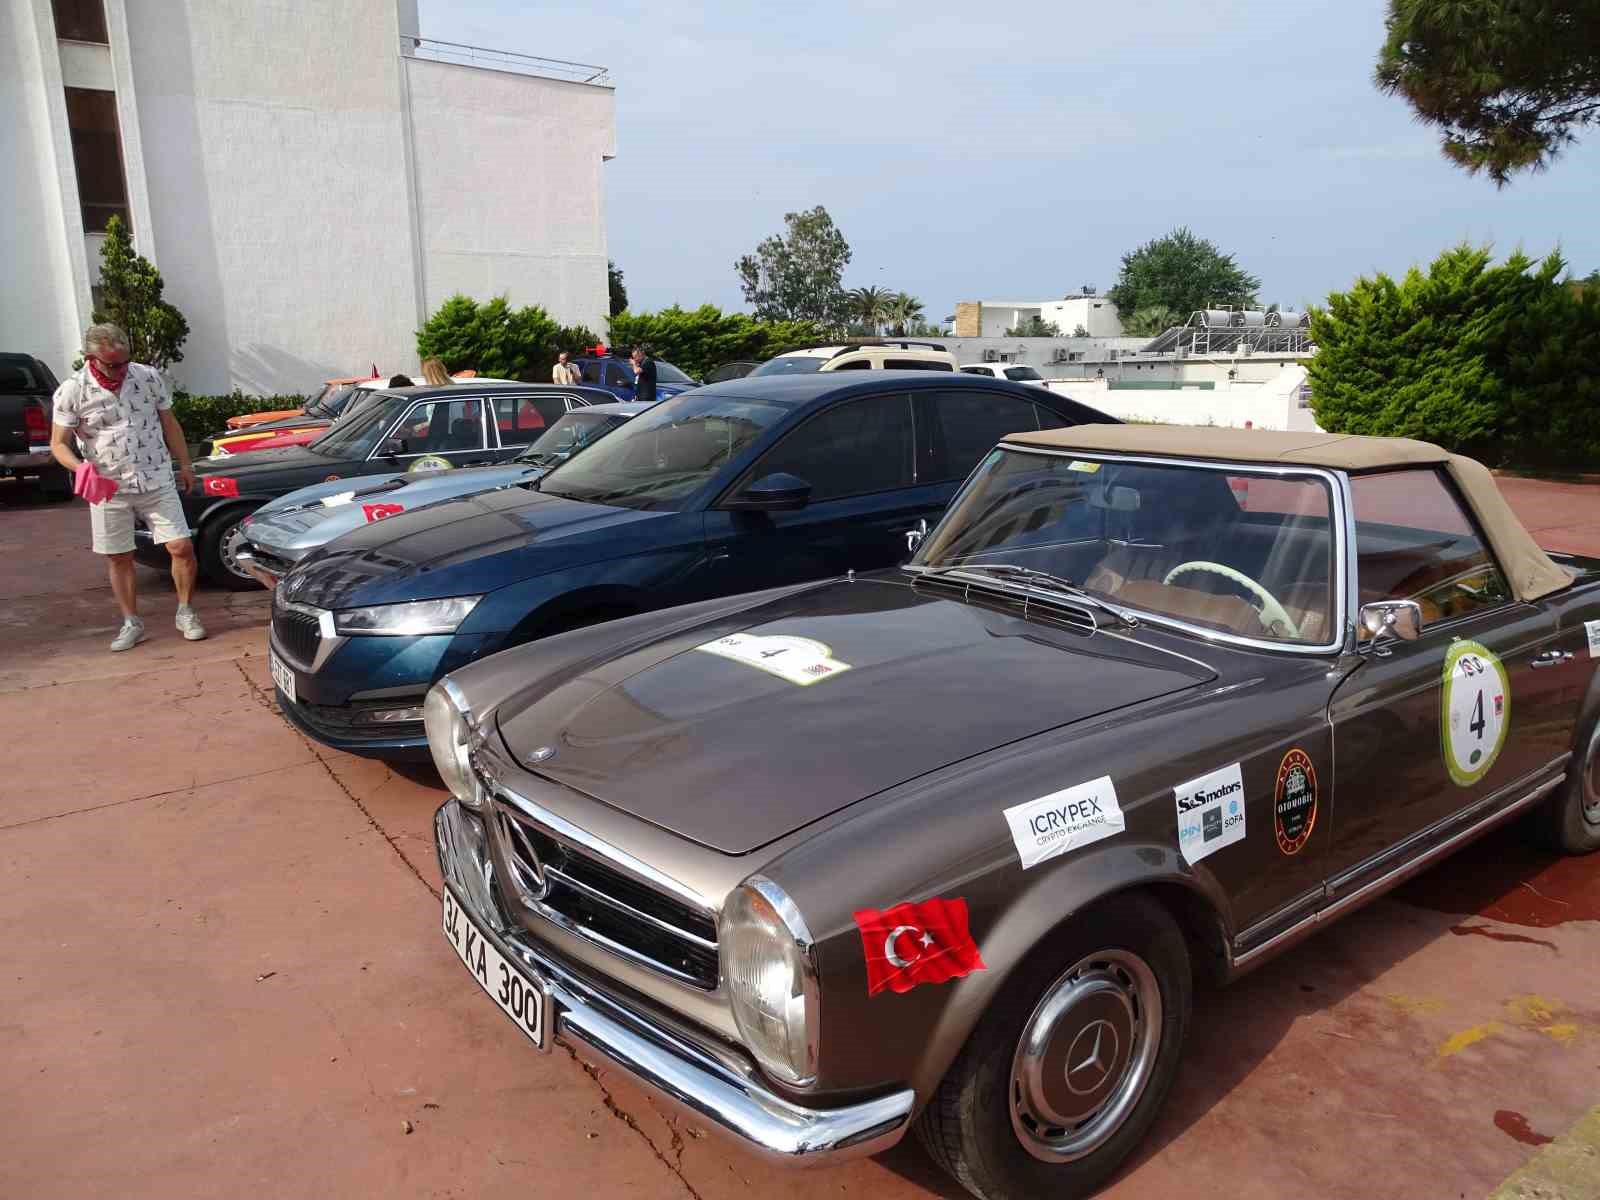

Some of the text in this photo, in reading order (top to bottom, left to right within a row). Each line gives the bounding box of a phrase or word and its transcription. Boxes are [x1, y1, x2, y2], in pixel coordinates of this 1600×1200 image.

[1470, 689, 1486, 740] 4
[1029, 796, 1102, 836] ICRYPEX
[1036, 815, 1106, 847] CRYPTO EXCHANGE
[1224, 814, 1243, 828] SOFA
[445, 895, 537, 1033] 34 KA 300
